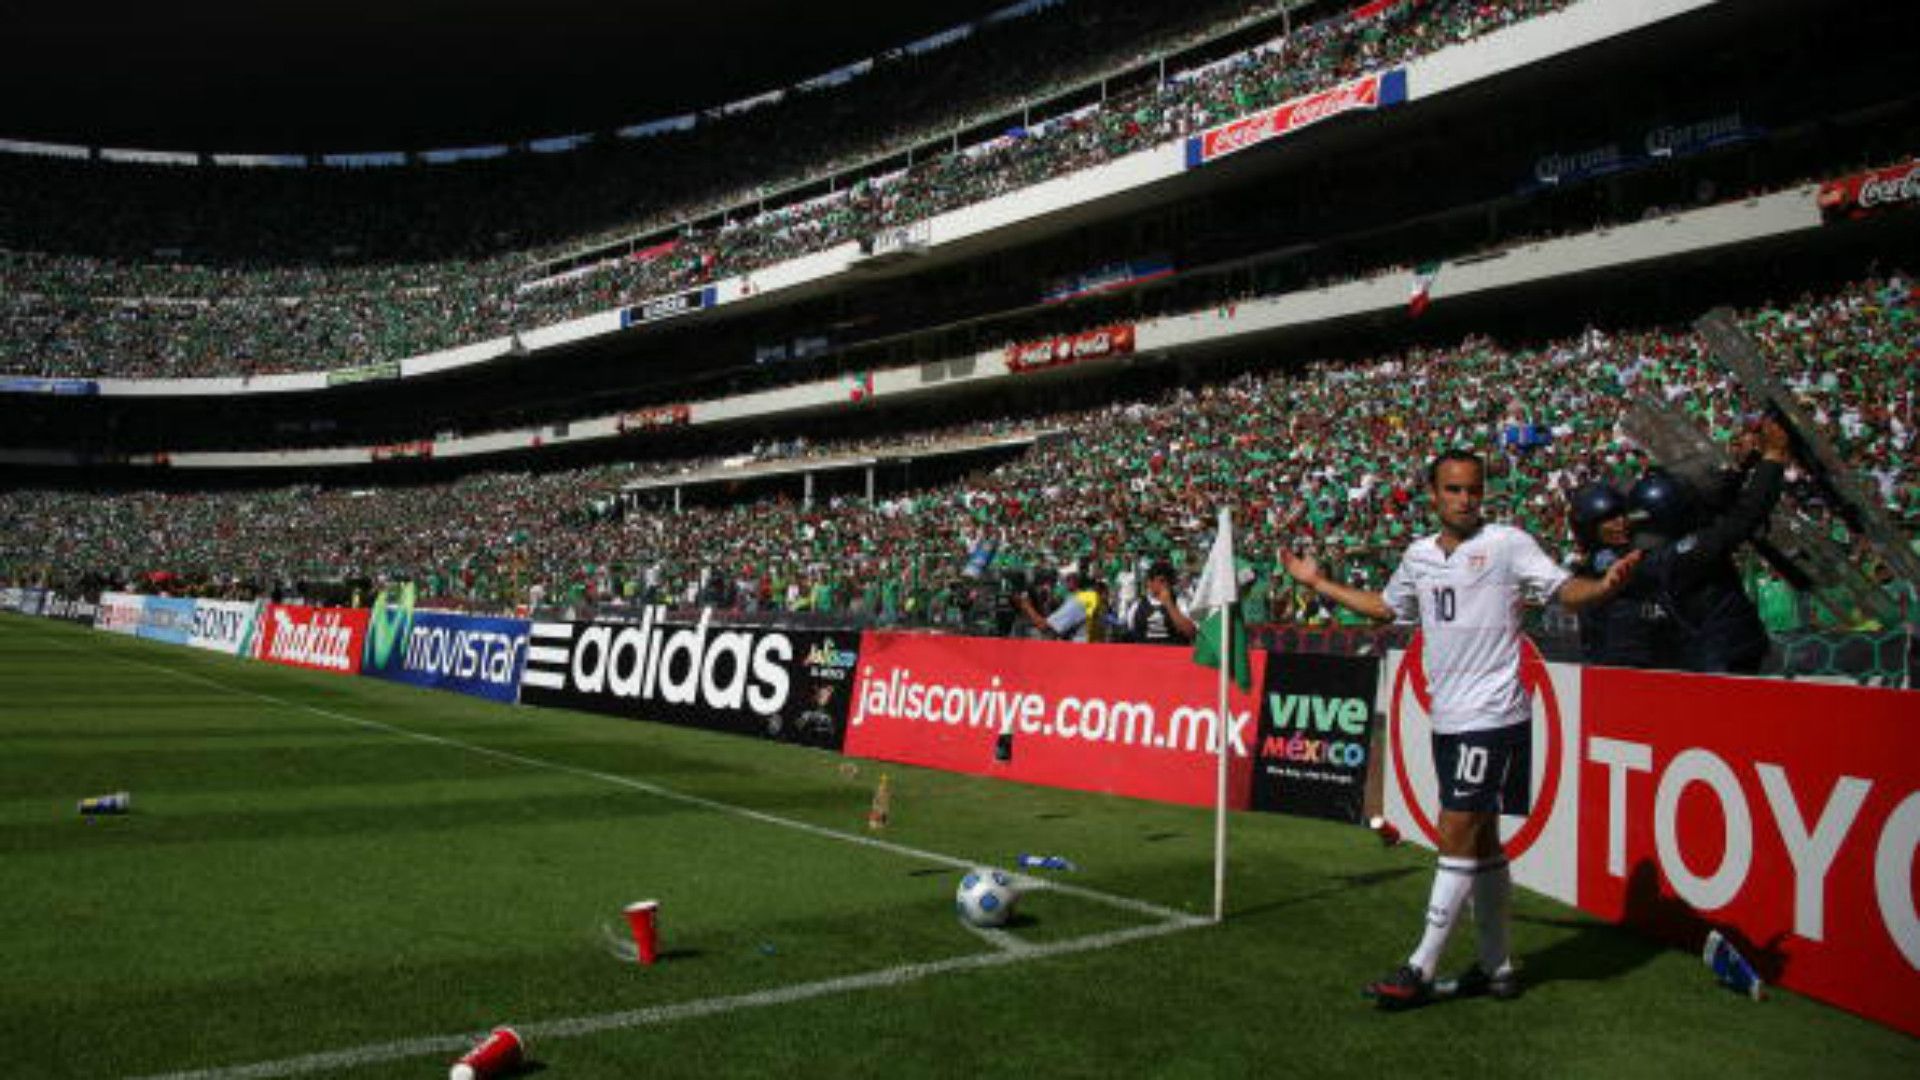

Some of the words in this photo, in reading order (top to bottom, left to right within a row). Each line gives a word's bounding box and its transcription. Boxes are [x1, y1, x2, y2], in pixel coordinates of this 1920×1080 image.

[191, 607, 244, 643] SONY
[1433, 587, 1456, 622] 10
[404, 627, 526, 684] movistar
[572, 604, 794, 715] adidas
[1456, 742, 1488, 784] 10
